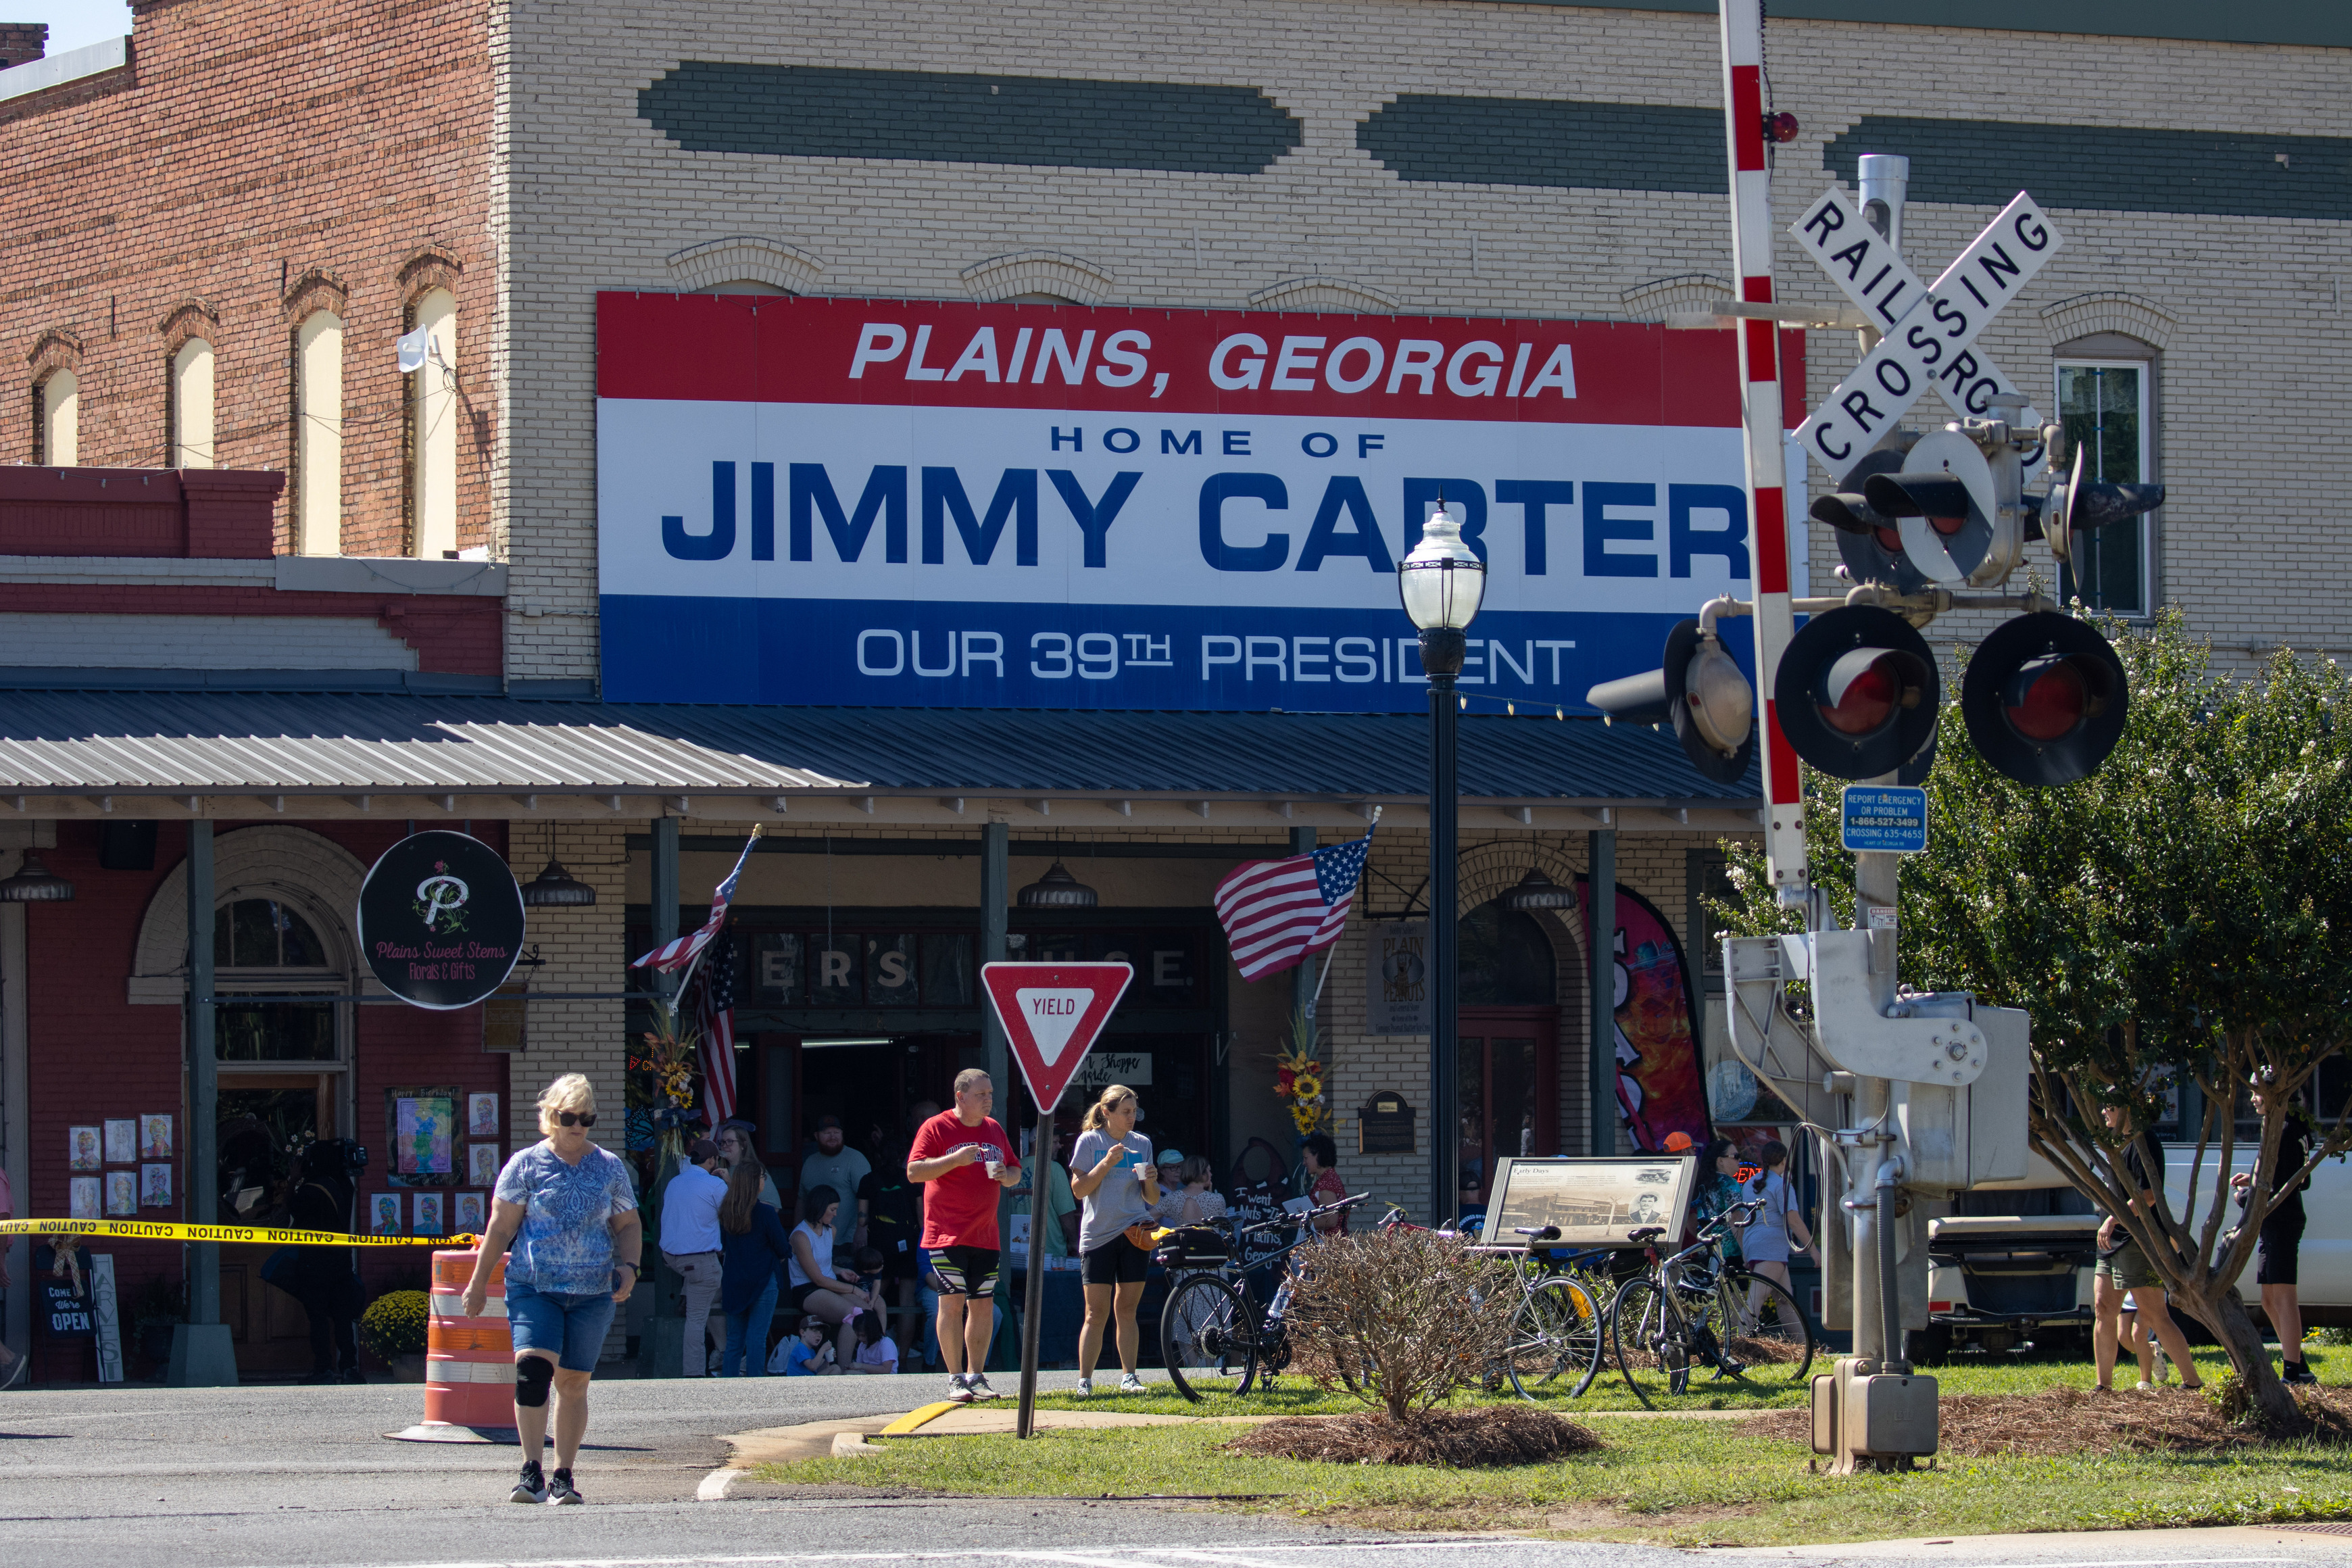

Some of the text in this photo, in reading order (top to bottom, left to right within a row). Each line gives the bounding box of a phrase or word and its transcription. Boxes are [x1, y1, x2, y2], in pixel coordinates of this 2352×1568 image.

[1804, 201, 1907, 325] RAIL
[1815, 212, 2049, 461] CROSSING
[848, 322, 1578, 400] PLAINS, GEORGIA
[1050, 426, 1386, 459] HOME OF
[660, 460, 1750, 580] JIMMY CARTER
[856, 629, 1004, 678] OUR
[1030, 631, 1174, 680] 39TH
[1848, 795, 1921, 806] REPORT EMERGENCY
[1861, 806, 1908, 816] OR PROBLEM
[1850, 816, 1919, 827] 1-866-527-3499
[1846, 828, 1922, 839] CROSSING 635-465S
[376, 941, 508, 959] Plains Sweet Stems
[409, 962, 439, 980] Florals
[450, 962, 475, 980] Gifts
[733, 939, 908, 988] ER'S
[1032, 998, 1075, 1016] YIELD
[1101, 1053, 1140, 1073] Shoppe
[391, 1088, 456, 1100] Happy Birthday!
[1234, 1186, 1248, 1198] I
[1248, 1192, 1273, 1206] went
[39, 1221, 97, 1233] CAUTION
[109, 1222, 174, 1237] CAUTION
[187, 1226, 254, 1241] CAUTION
[267, 1229, 335, 1244] CAUTION
[347, 1234, 414, 1245] CAUTION
[55, 1300, 81, 1310] We're
[51, 1312, 91, 1331] OPEN
[93, 1256, 120, 1380] HARVEST
